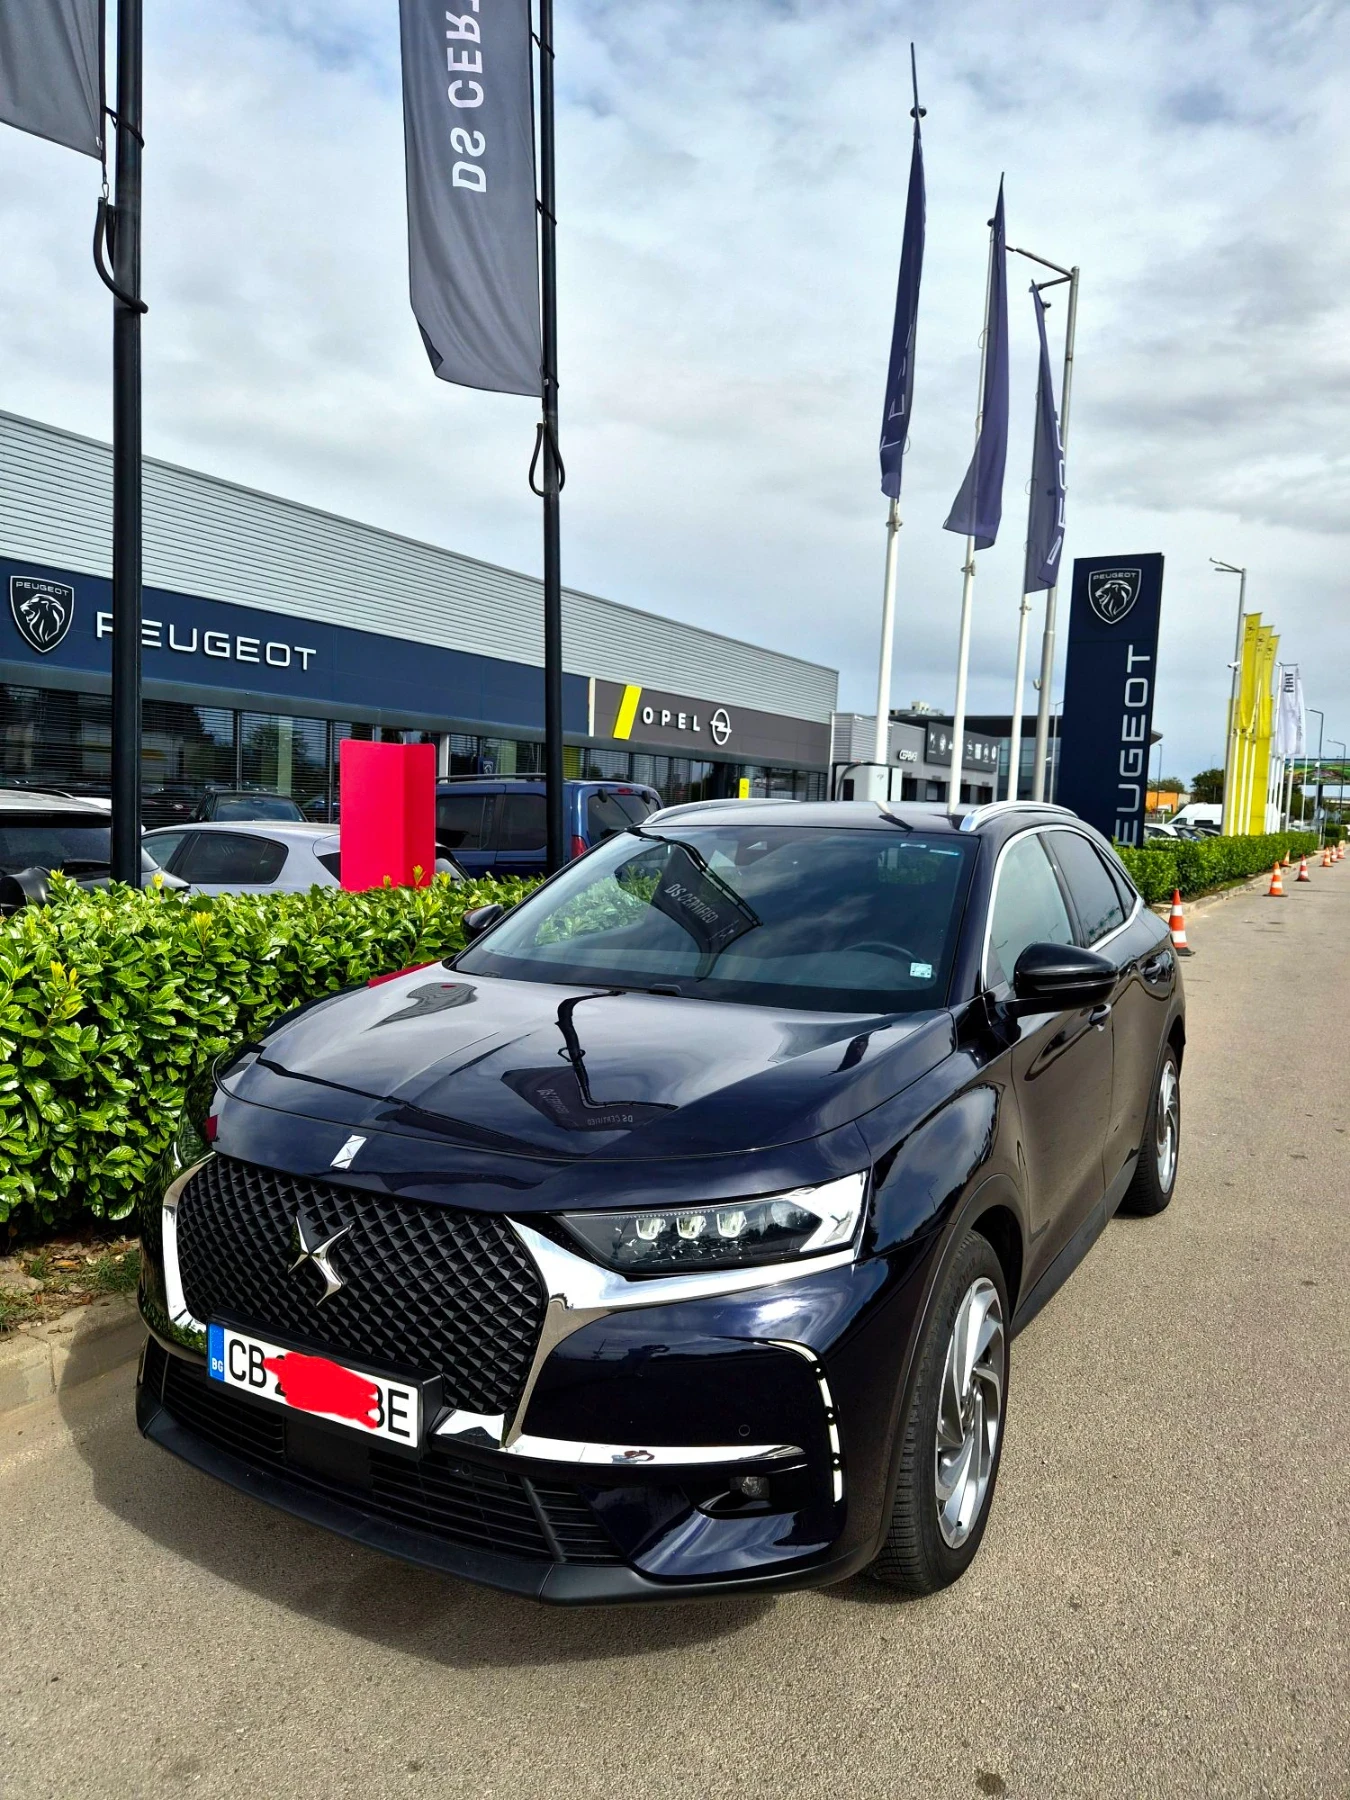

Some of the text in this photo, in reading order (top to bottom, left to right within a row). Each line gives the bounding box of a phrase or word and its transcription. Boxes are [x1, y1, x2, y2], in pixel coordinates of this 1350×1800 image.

[1093, 572, 1137, 580] PEUGEOT
[15, 581, 70, 596] PEUGEOT
[1283, 672, 1295, 693] FIAT
[642, 706, 701, 732] OPEL
[1114, 644, 1150, 847] EUGEOT
[663, 883, 719, 924] DS CERTIFIED
[211, 1357, 224, 1373] BG
